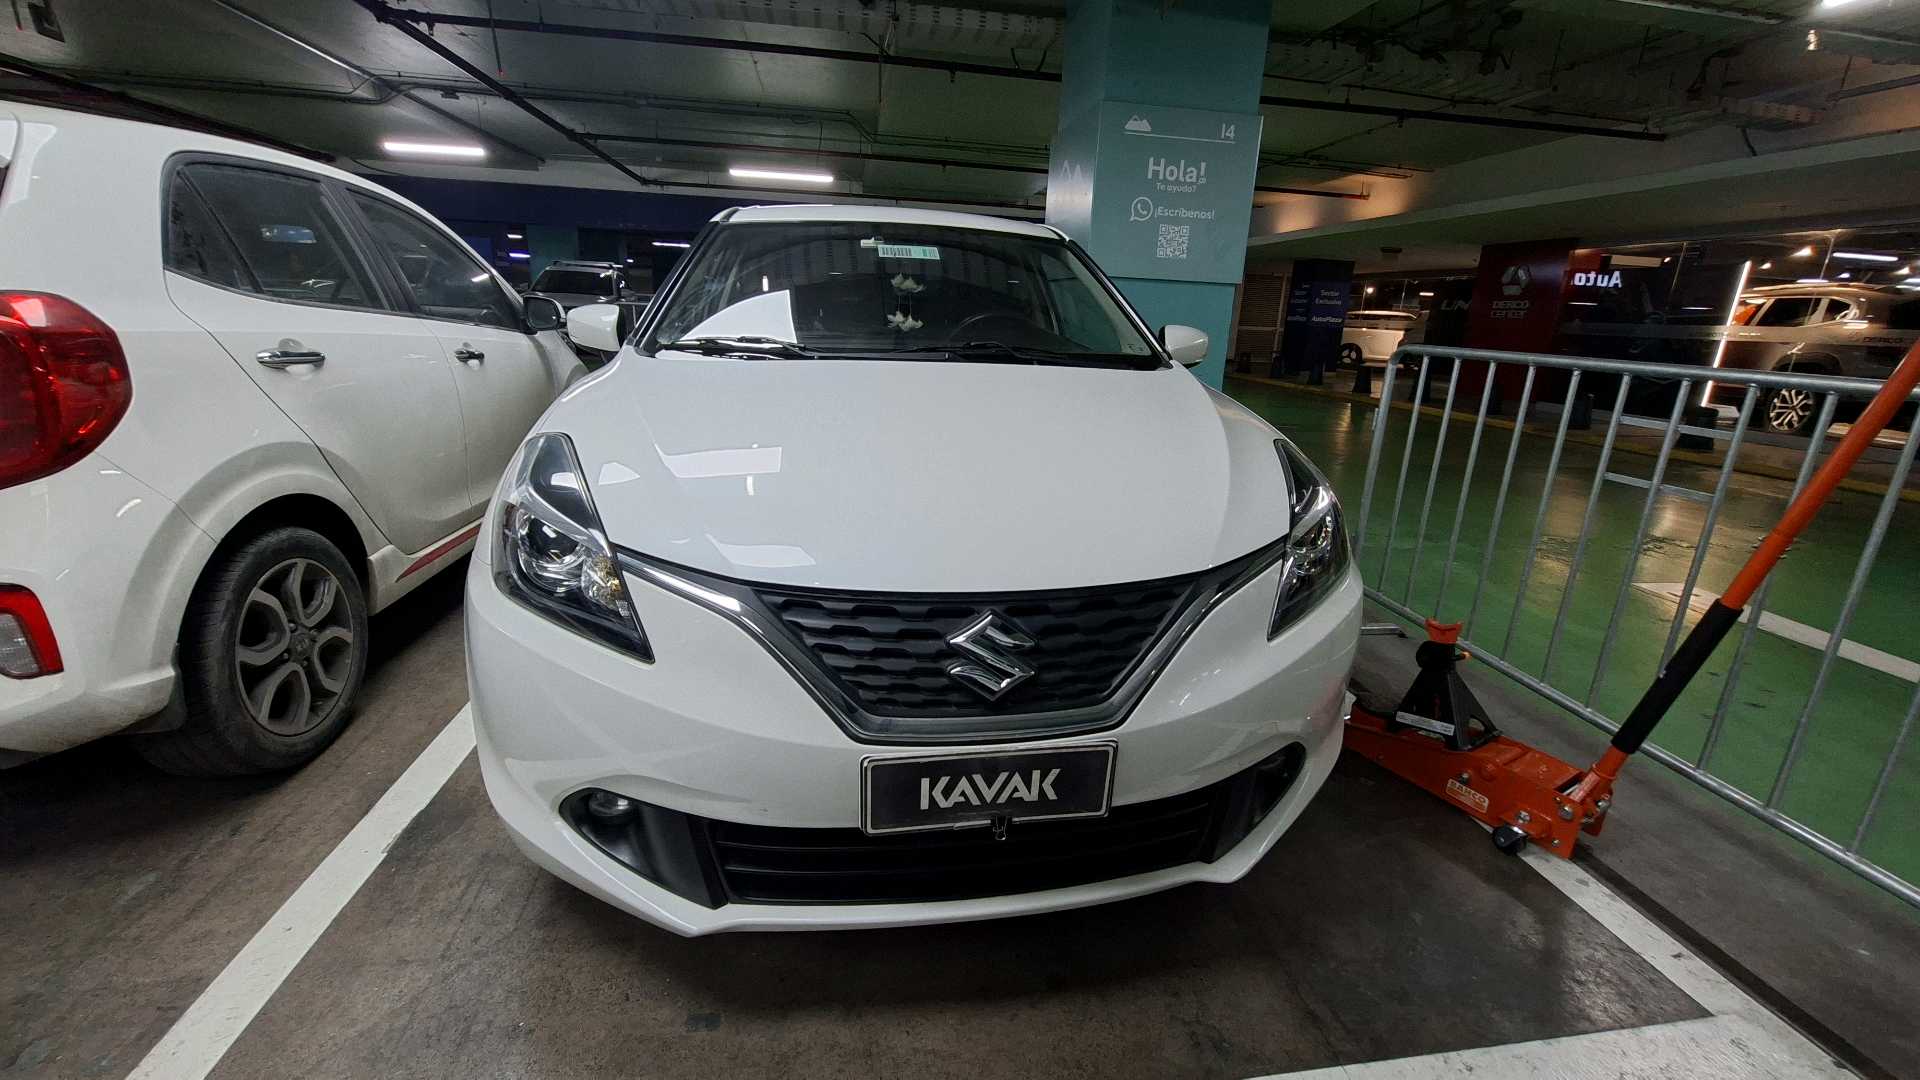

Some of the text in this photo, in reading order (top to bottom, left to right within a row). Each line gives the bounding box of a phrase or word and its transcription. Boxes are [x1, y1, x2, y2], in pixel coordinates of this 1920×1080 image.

[1147, 157, 1207, 184] Hola!
[1156, 182, 1166, 191] Te
[919, 768, 1062, 810] KAVAK
